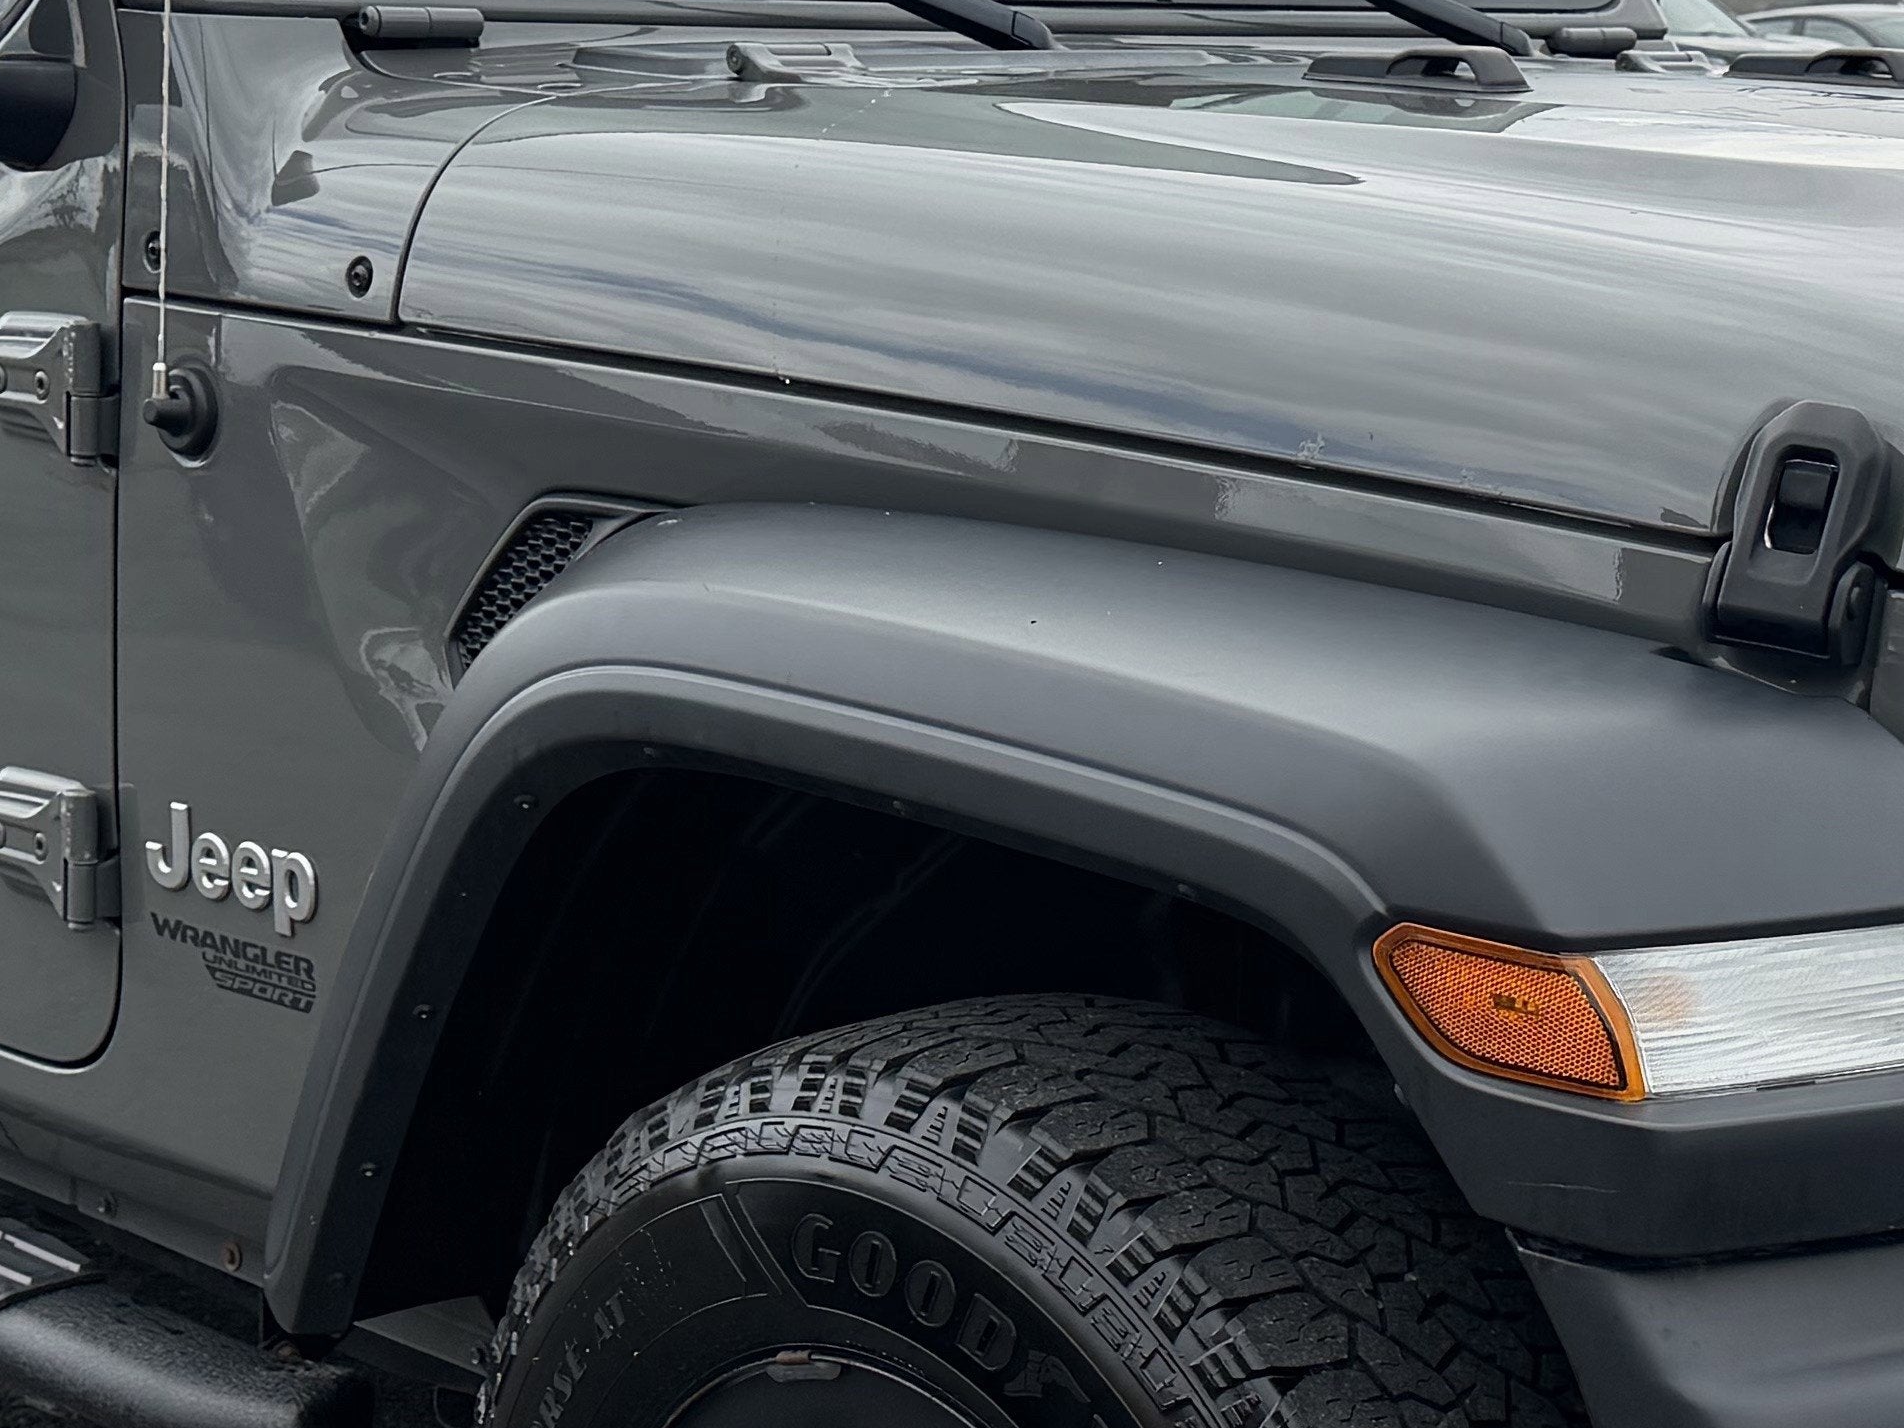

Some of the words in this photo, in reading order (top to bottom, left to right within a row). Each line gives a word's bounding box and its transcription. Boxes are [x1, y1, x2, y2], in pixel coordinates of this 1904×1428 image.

[145, 800, 319, 938] Jeep
[150, 911, 317, 982] WRANGLER
[202, 950, 317, 993] UNLIMITED
[212, 971, 315, 1012] SPORT
